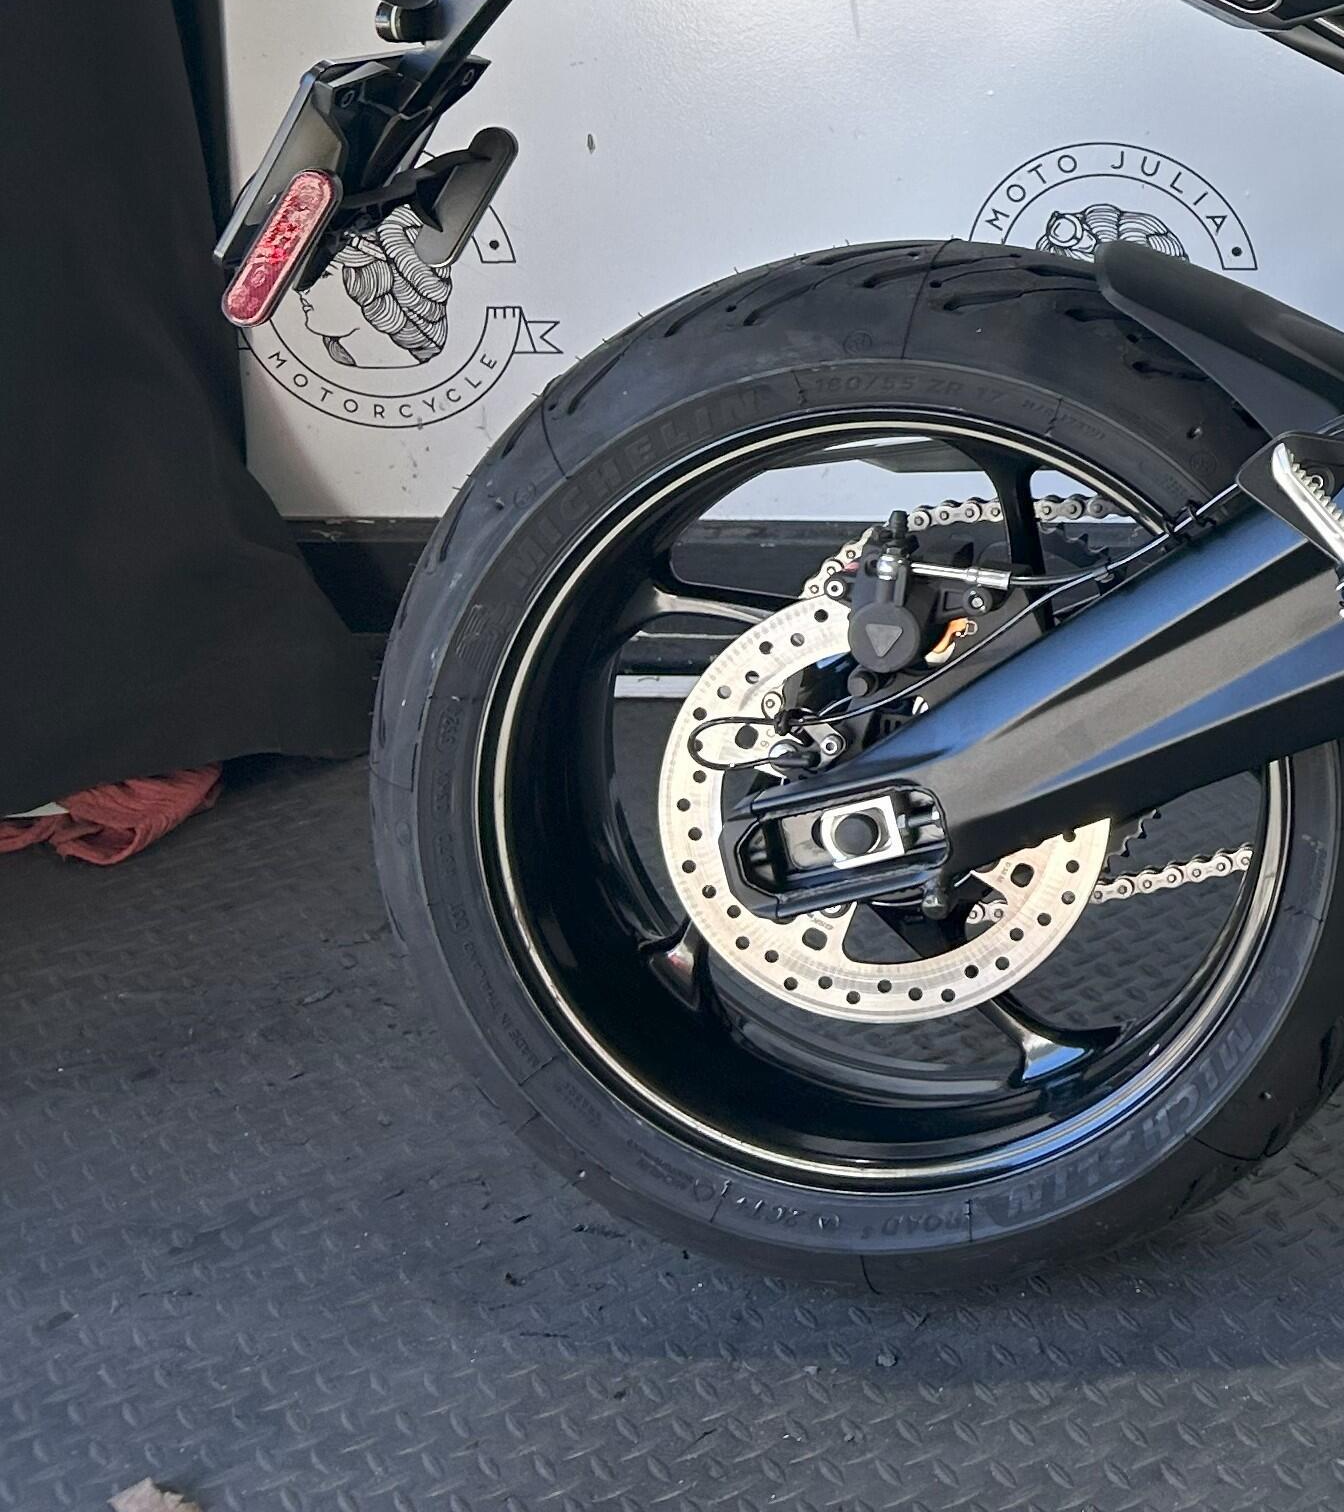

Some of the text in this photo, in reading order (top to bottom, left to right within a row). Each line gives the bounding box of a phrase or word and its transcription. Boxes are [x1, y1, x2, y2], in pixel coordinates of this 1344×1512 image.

[984, 150, 1228, 235] MOTO JULIA
[267, 350, 498, 419] MOTORCYCLE
[503, 384, 768, 591] MICHELIN
